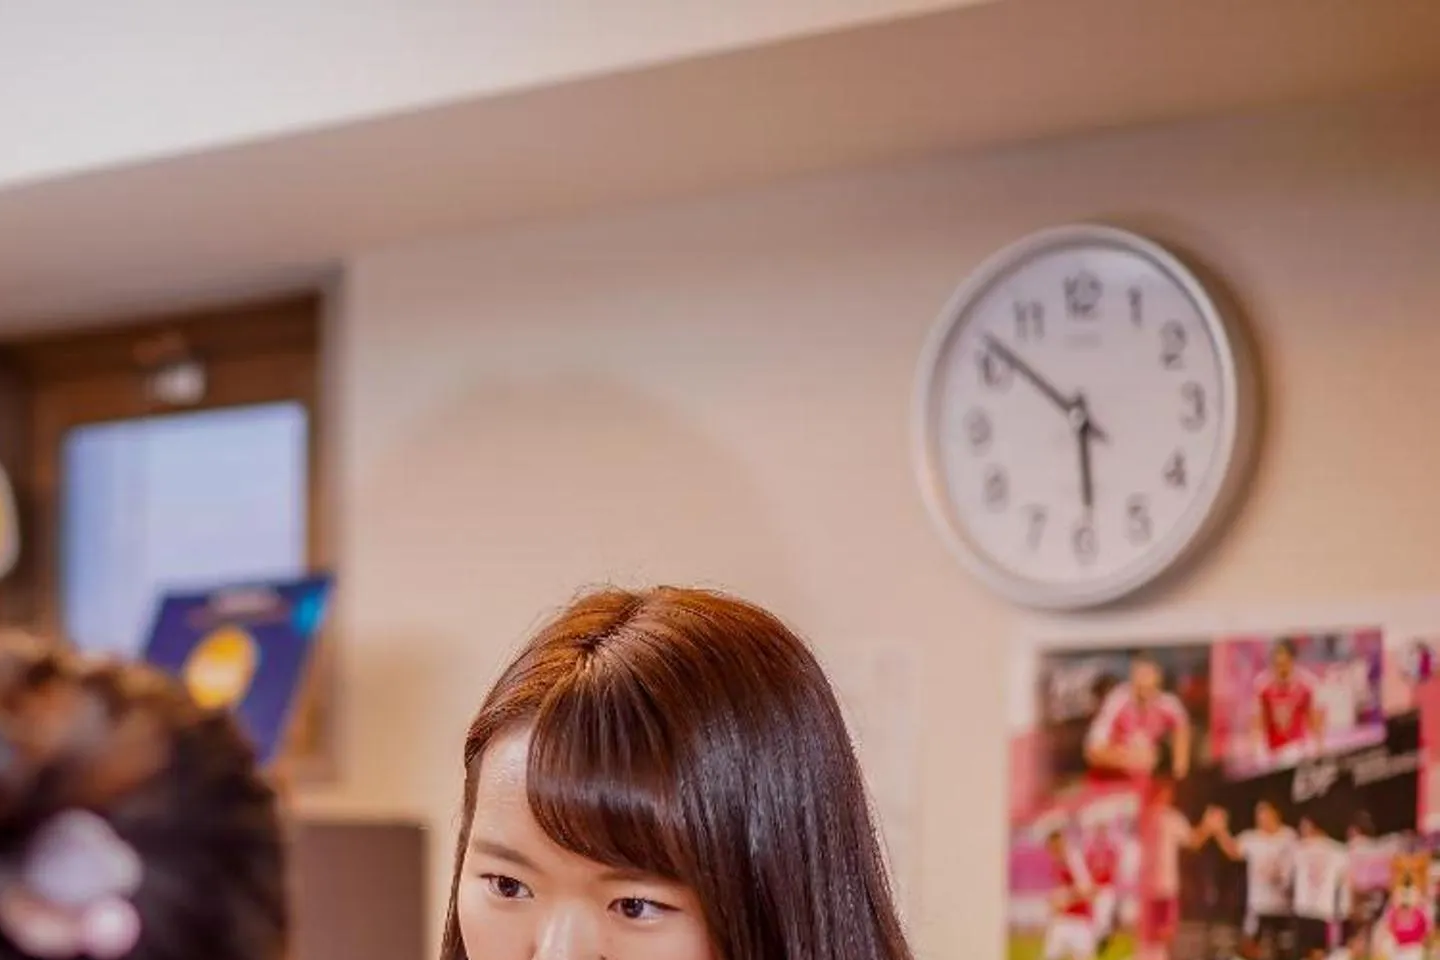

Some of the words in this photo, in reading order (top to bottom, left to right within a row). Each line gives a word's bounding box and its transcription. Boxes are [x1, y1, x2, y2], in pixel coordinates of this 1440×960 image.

[1063, 270, 1103, 320] 12
[1128, 285, 1143, 328] 1
[1014, 299, 1044, 341] 11
[1161, 319, 1187, 370] 2
[1181, 380, 1207, 432] 3
[1164, 450, 1187, 490] 4
[1024, 503, 1048, 550] 7
[1126, 494, 1152, 545] 5
